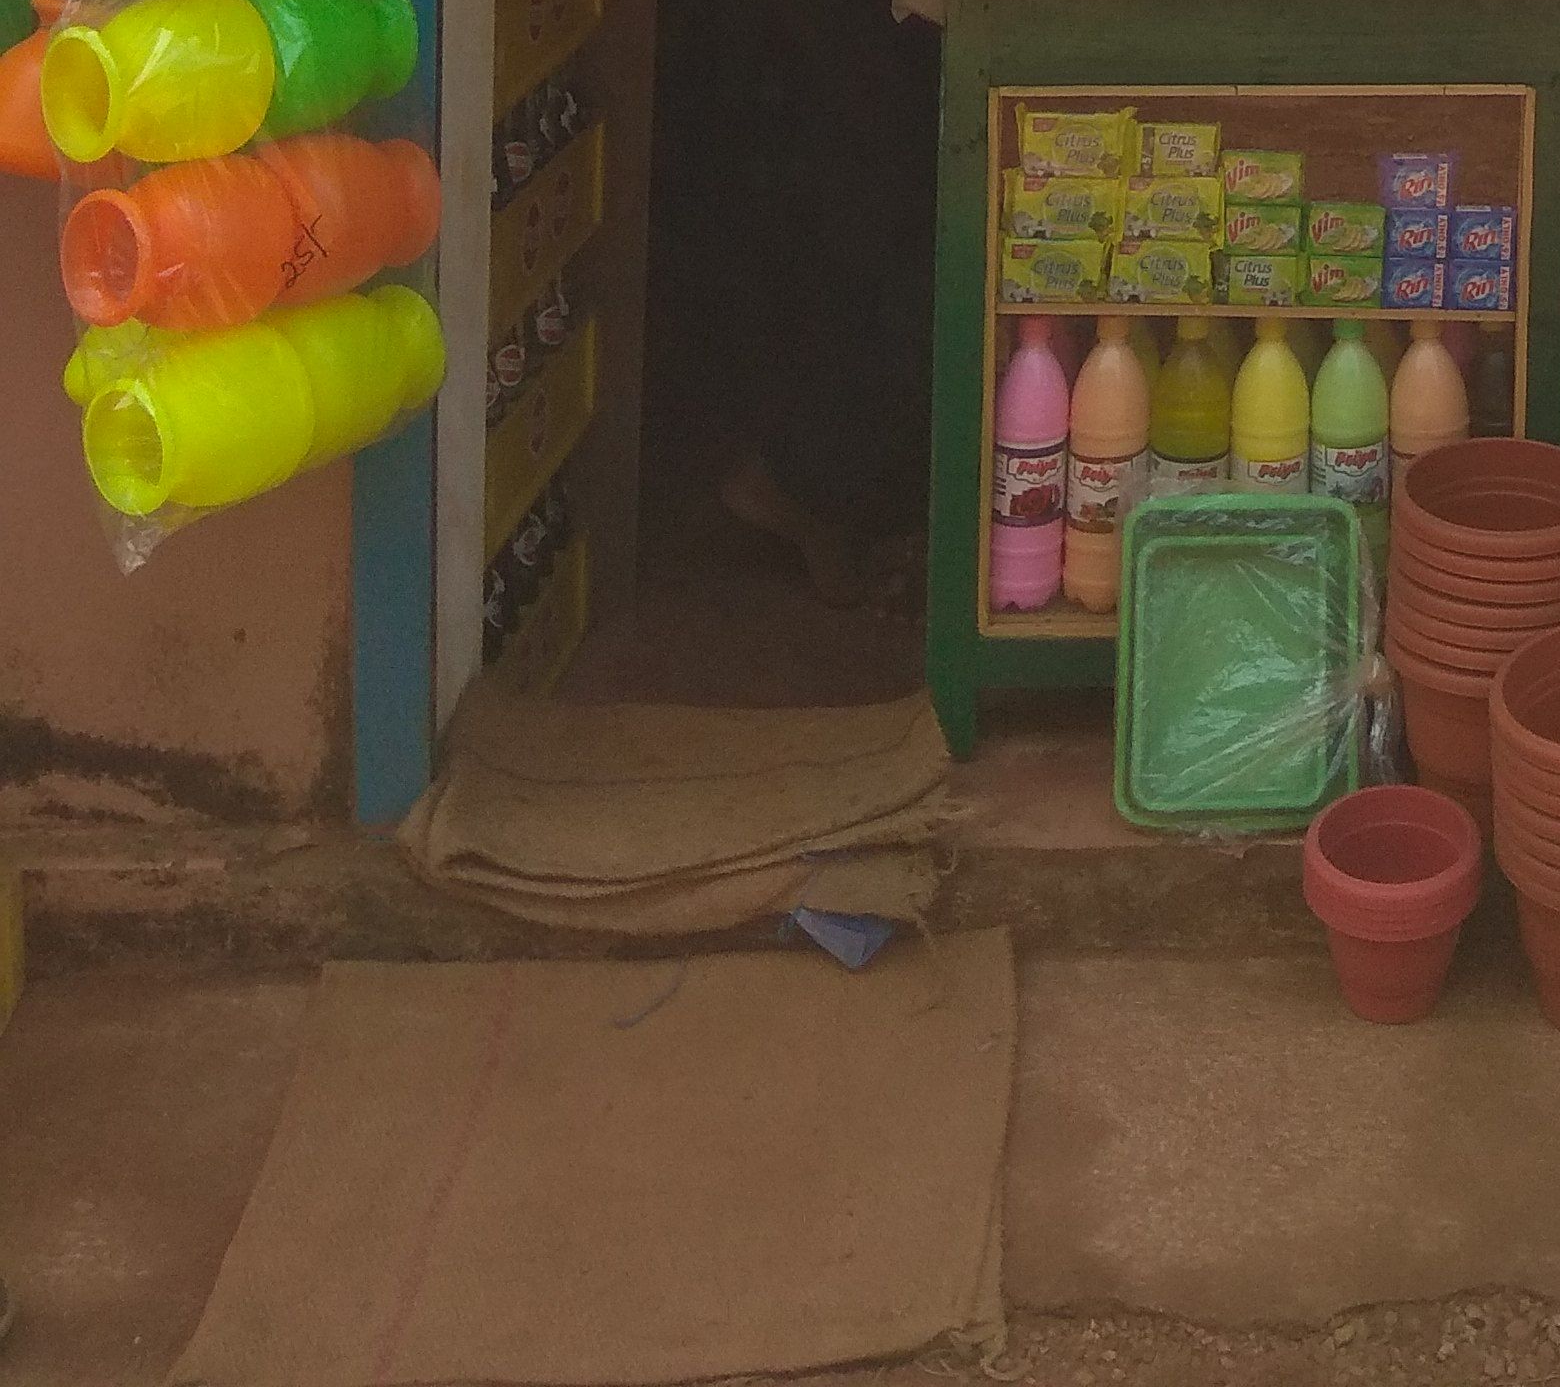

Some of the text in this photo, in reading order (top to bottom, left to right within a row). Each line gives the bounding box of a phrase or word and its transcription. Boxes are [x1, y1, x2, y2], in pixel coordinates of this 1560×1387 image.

[1055, 132, 1100, 148] Citrus
[1159, 131, 1198, 146] Citrus
[1067, 150, 1096, 164] Plus
[1167, 145, 1195, 159] Plus
[1225, 159, 1262, 192] Vim
[1150, 191, 1196, 207] Citrus
[1399, 176, 1433, 200] Rin
[1226, 211, 1261, 245] Vim
[1310, 211, 1345, 244] Vim
[1397, 227, 1434, 252] Rin
[1461, 227, 1498, 253] Rin
[1139, 255, 1185, 272] Citrus
[1234, 260, 1273, 274] Citrus
[1243, 273, 1271, 287] Plus
[1311, 263, 1345, 293] Vim
[1393, 277, 1430, 301] Rin
[1459, 278, 1496, 302] Rin
